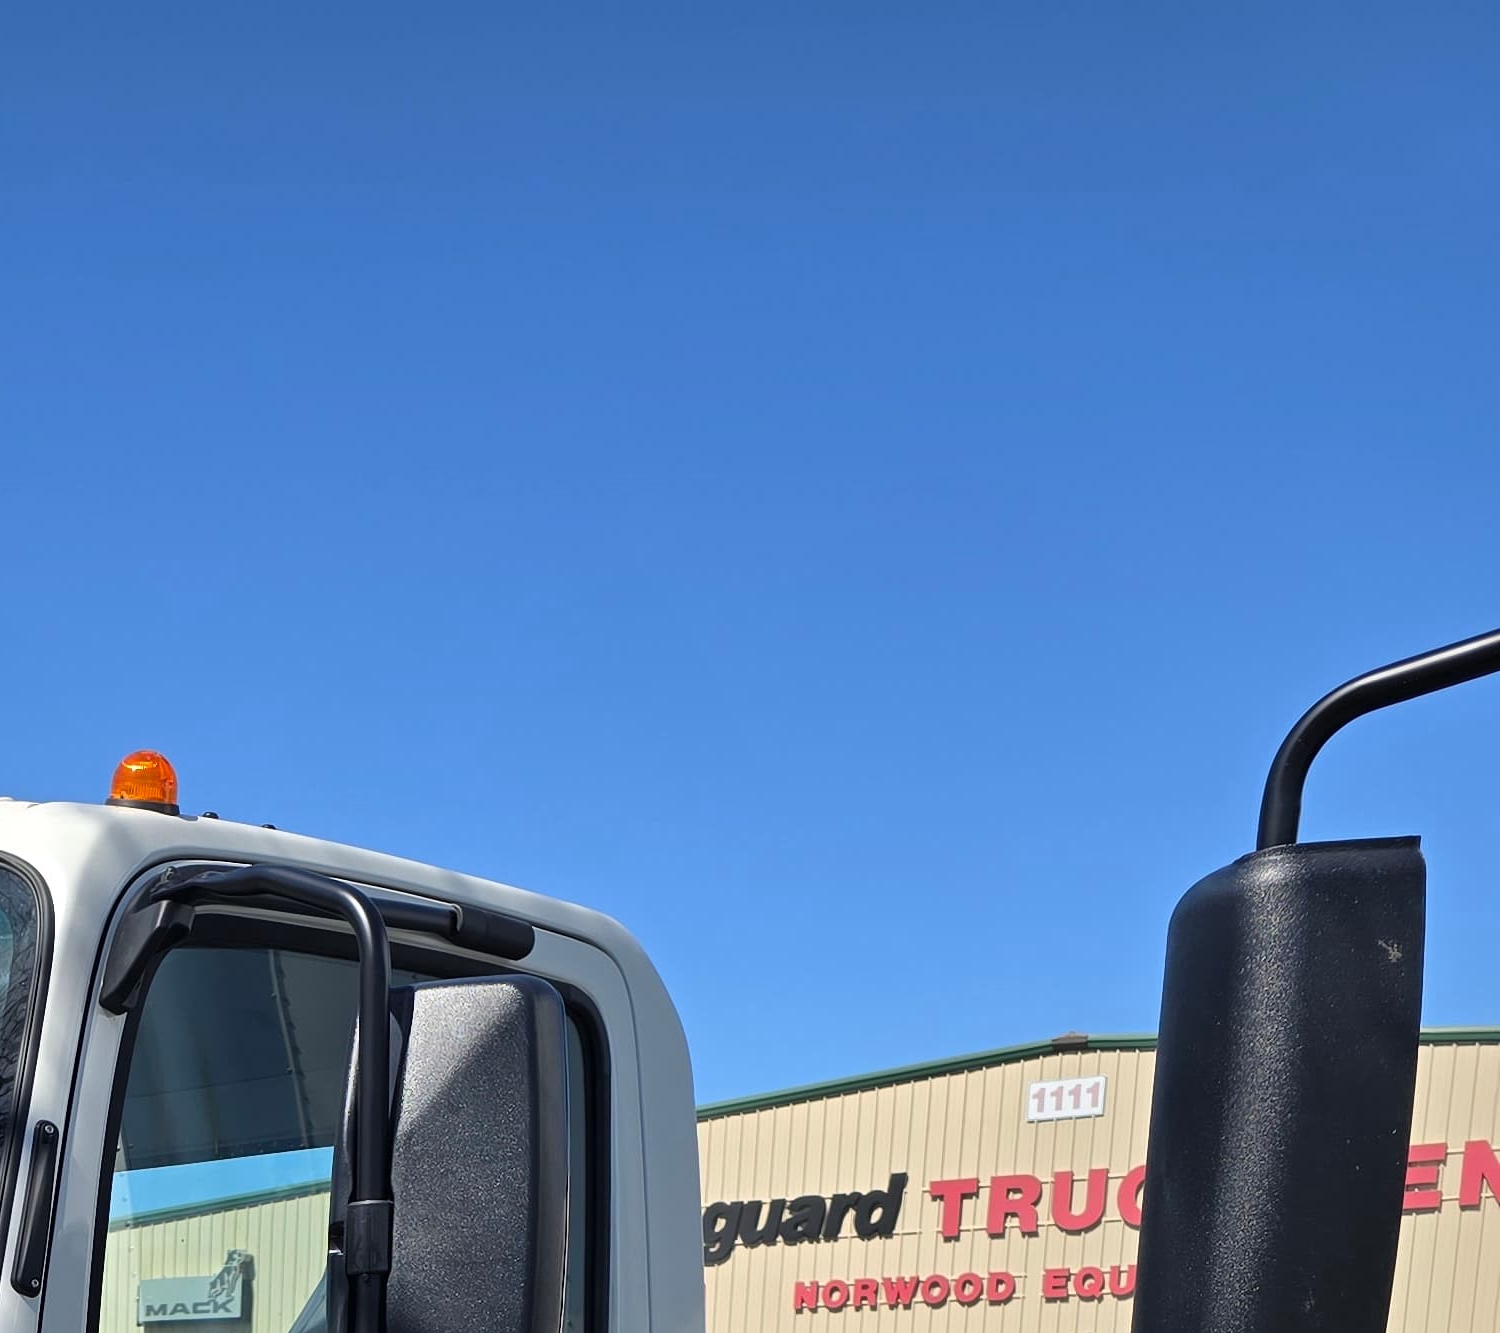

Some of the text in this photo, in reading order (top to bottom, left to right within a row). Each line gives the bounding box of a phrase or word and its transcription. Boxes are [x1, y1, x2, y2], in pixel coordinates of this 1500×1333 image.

[1032, 1082, 1101, 1113] 1111
[703, 1172, 908, 1266] guard
[145, 1298, 235, 1317] MACK
[794, 1265, 1137, 1312] NORWOOD EQU
